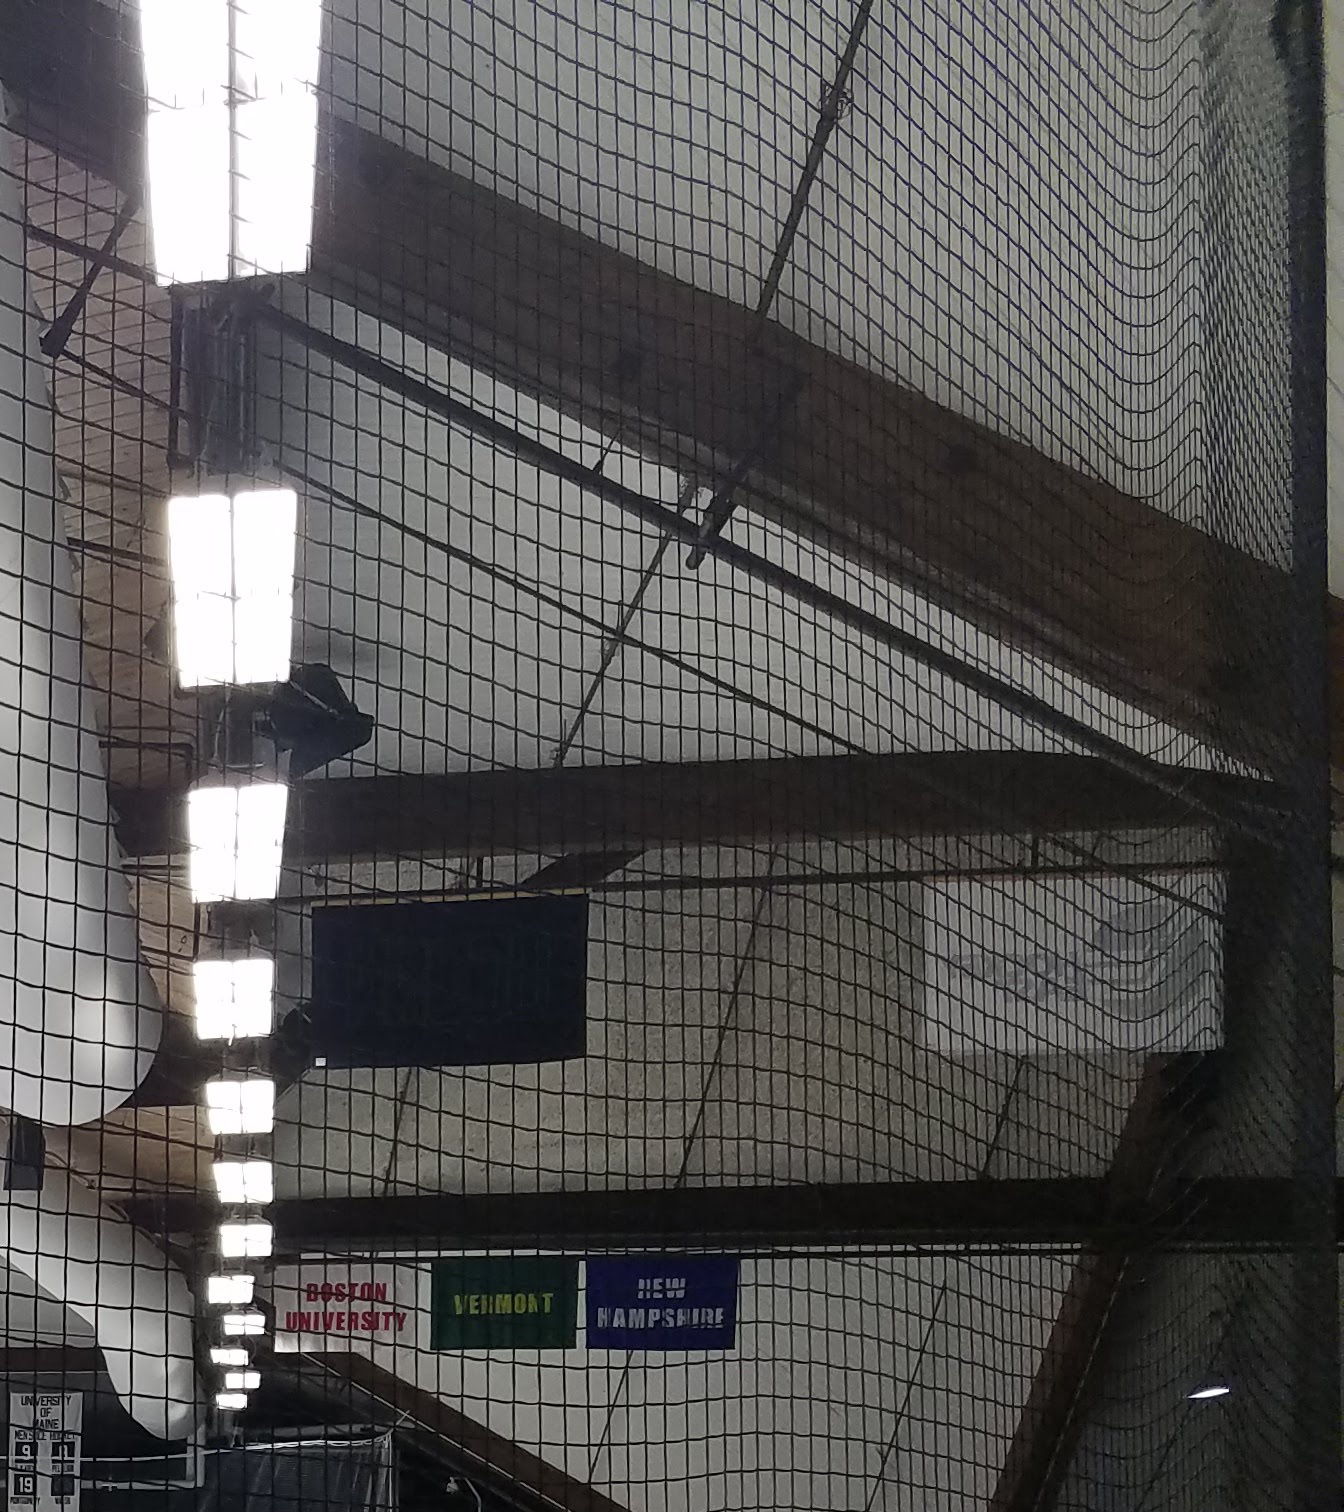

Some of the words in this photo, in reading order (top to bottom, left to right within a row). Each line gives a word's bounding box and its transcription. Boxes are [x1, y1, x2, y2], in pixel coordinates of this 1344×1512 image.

[306, 1282, 387, 1303] BOSTON
[453, 1292, 554, 1316] VERMONT
[285, 1311, 408, 1333] UNIVERSITY
[20, 1395, 72, 1406] UNVERSIY
[18, 1476, 34, 1493] 19
